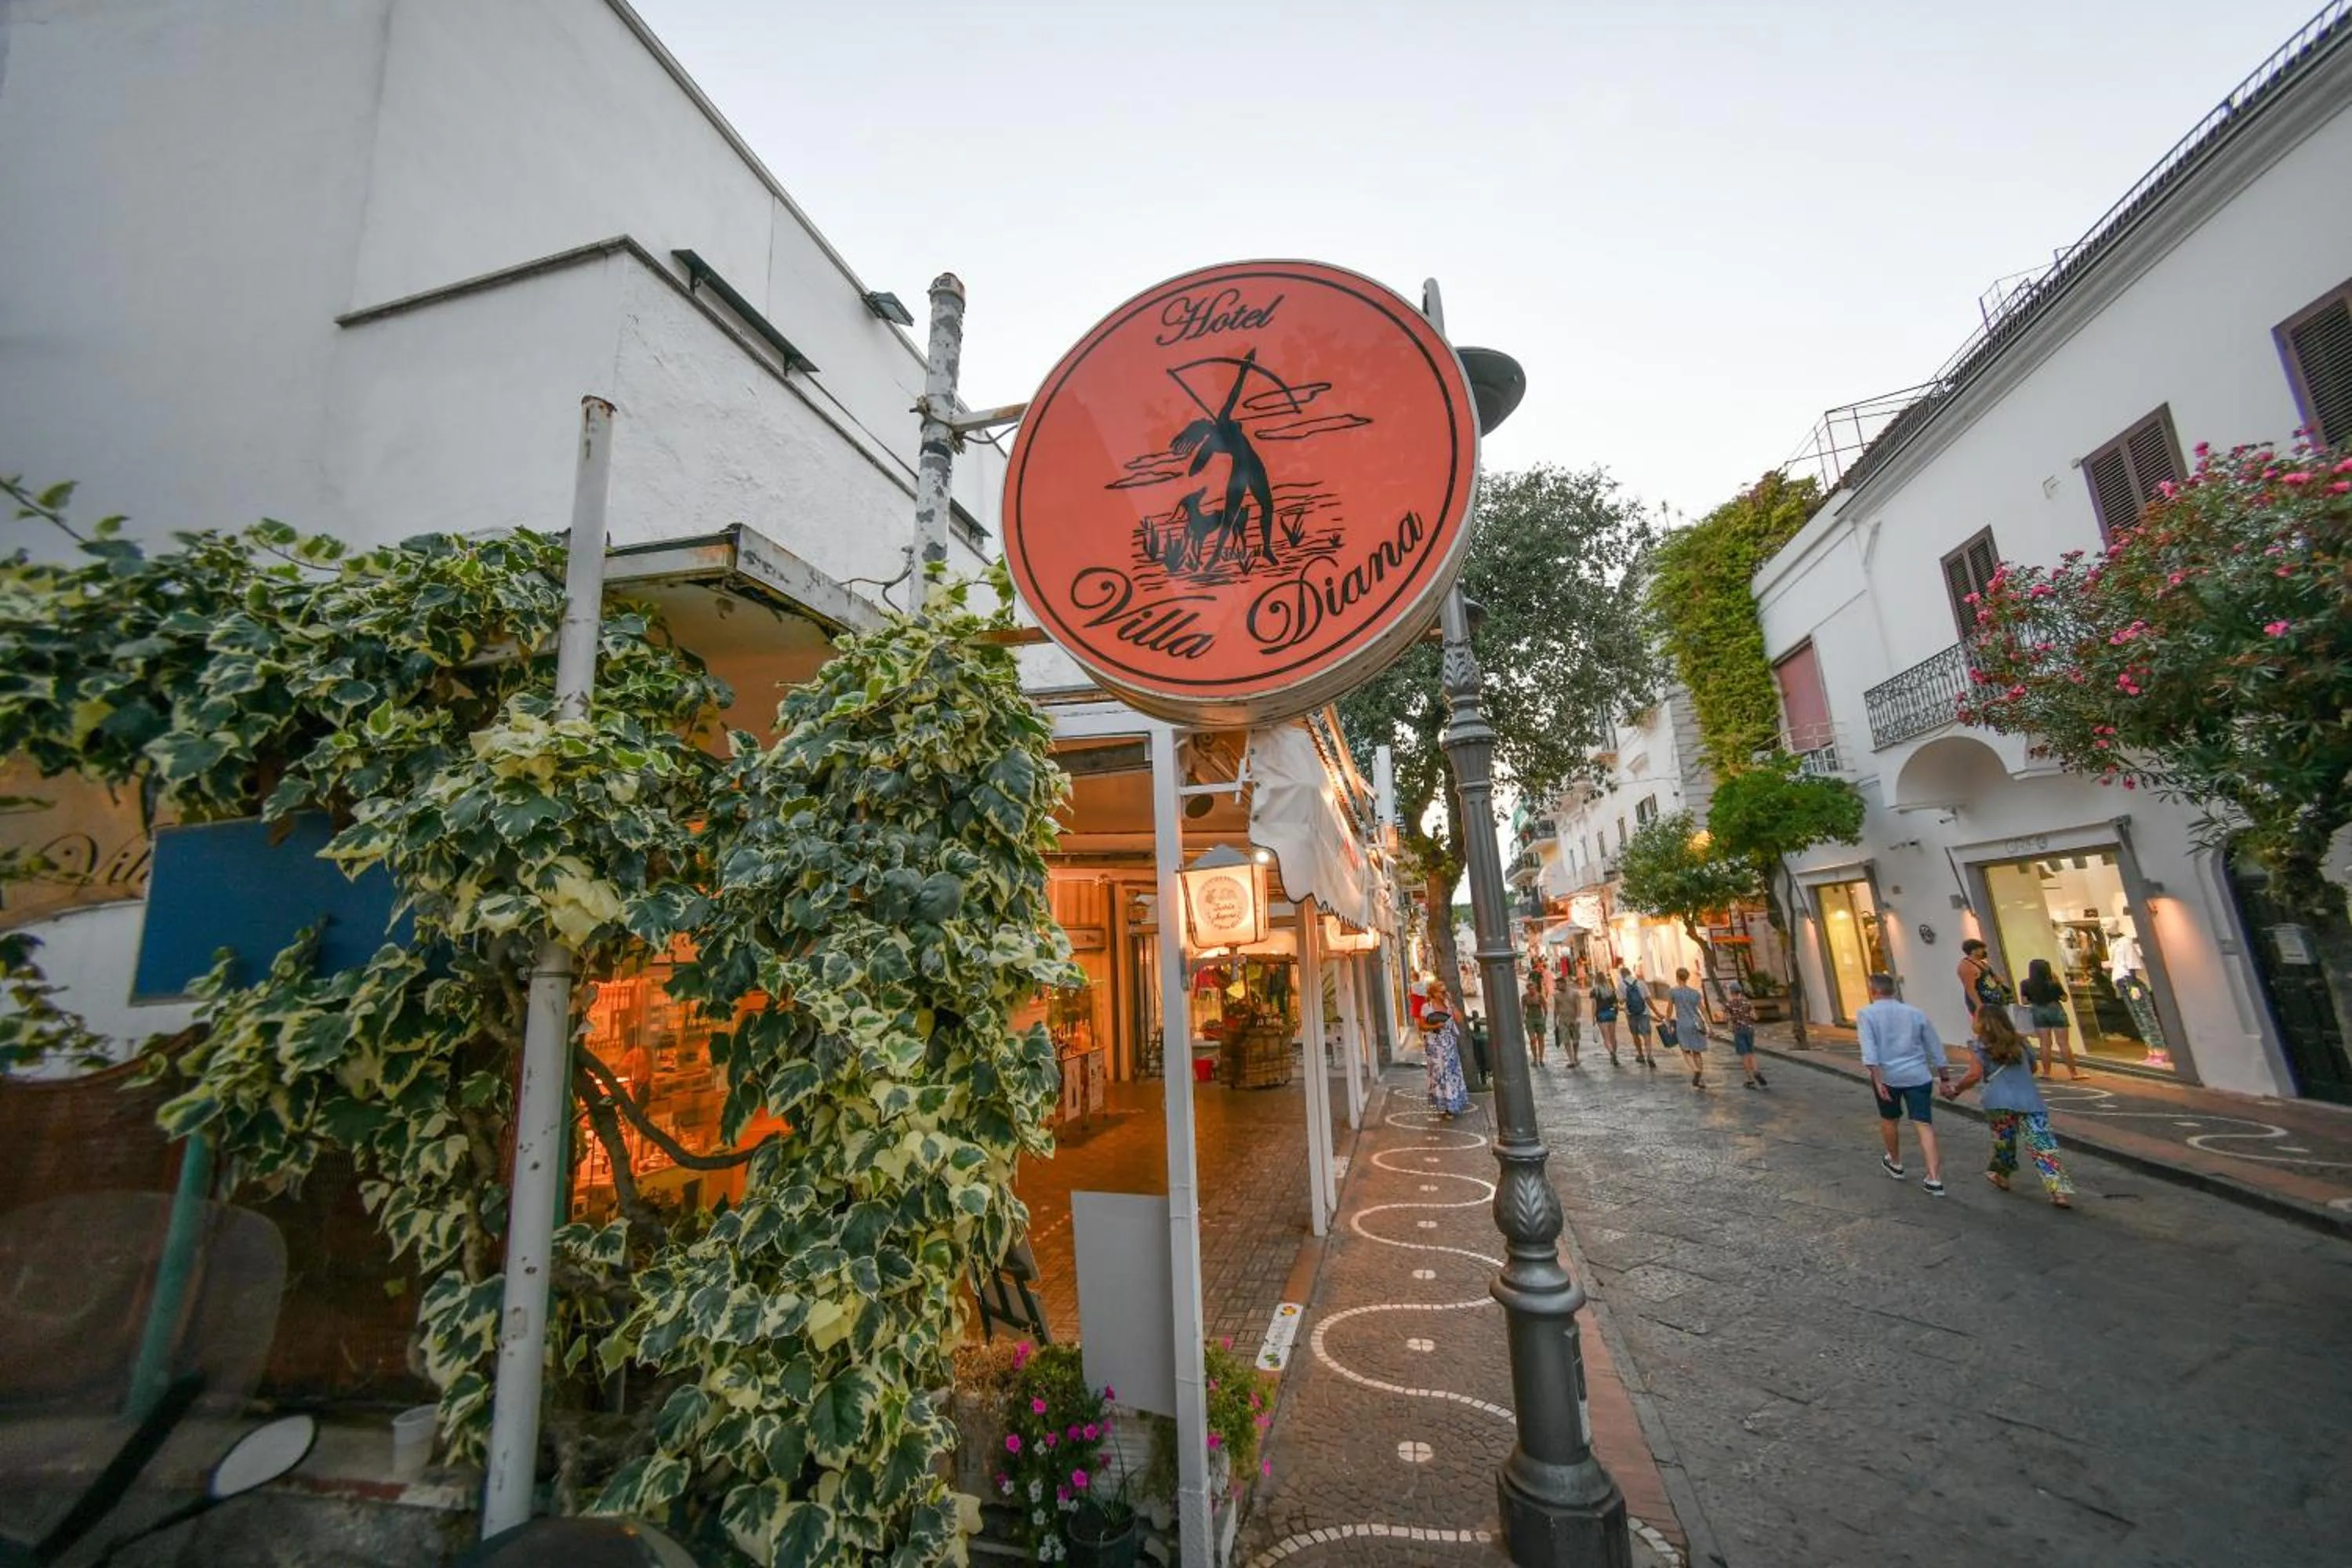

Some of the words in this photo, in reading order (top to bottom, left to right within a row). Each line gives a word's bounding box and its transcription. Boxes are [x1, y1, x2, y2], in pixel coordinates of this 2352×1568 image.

[1156, 289, 1285, 347] Hotel
[1071, 566, 1218, 660] Villa
[1246, 510, 1424, 655] Diana
